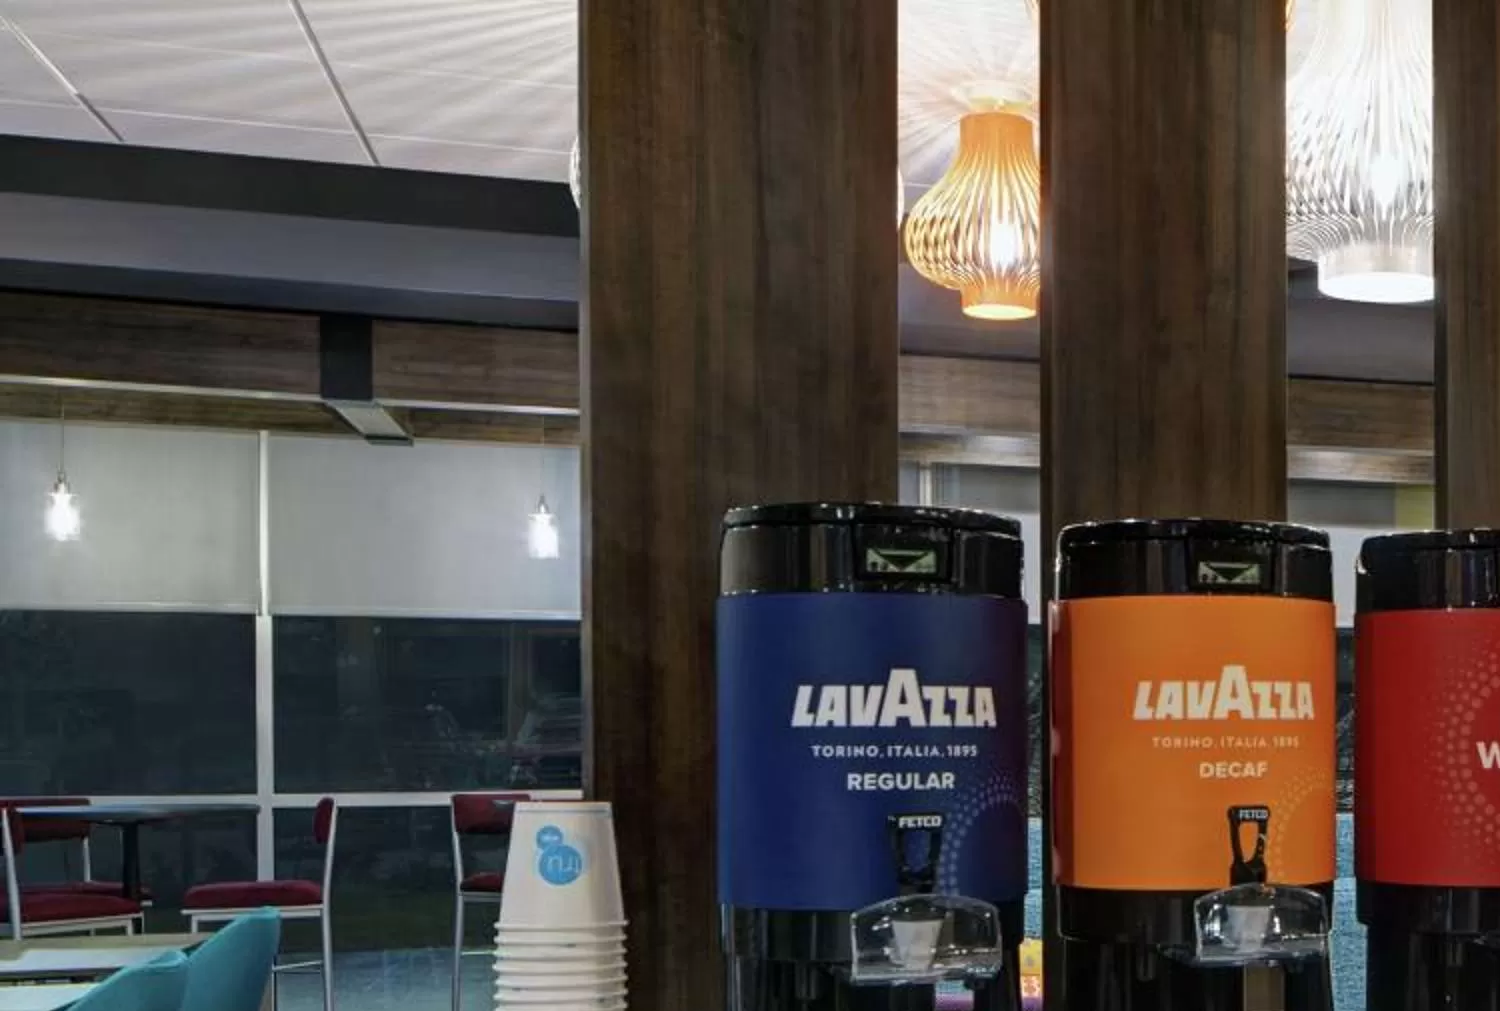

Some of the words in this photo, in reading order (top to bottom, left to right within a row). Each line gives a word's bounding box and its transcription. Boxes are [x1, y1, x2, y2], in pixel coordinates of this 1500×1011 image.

[790, 668, 997, 728] LAVAZZA
[1133, 665, 1314, 721] LAVAZZA
[847, 773, 955, 791] REGULAR
[1199, 761, 1269, 778] DECAF
